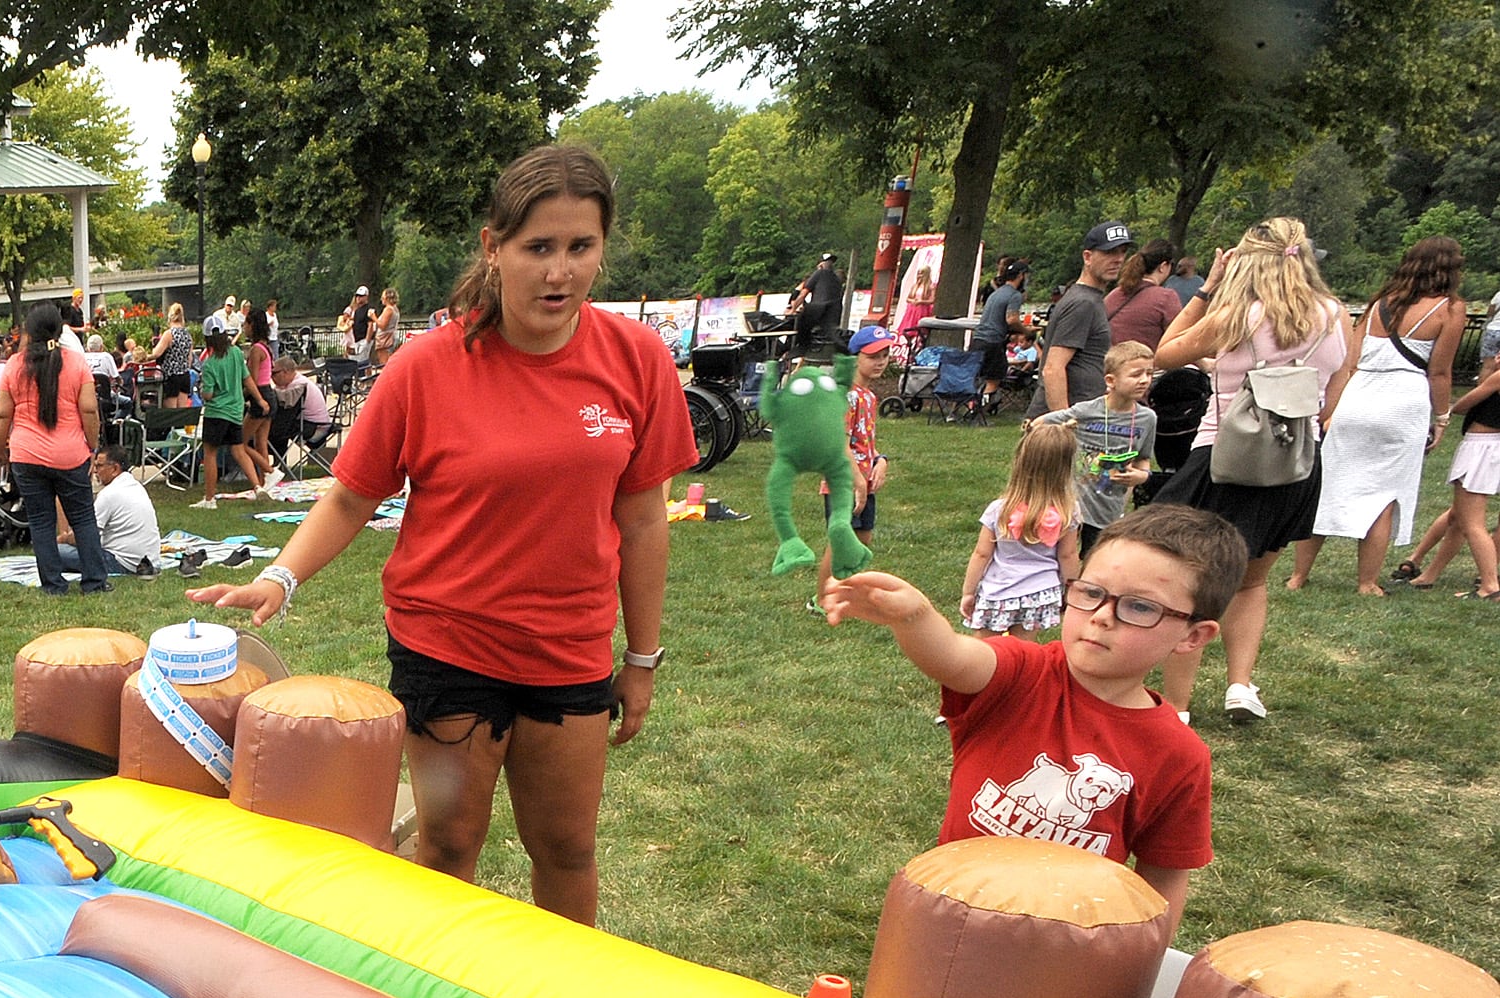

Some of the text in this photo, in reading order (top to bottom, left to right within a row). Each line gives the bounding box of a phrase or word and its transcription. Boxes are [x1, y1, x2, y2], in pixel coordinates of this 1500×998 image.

[172, 655, 197, 663] TICKET
[204, 650, 225, 662] TICKET
[181, 705, 202, 729] TICKET
[202, 727, 223, 750] TICKET
[975, 780, 1107, 854] BATAVIA
